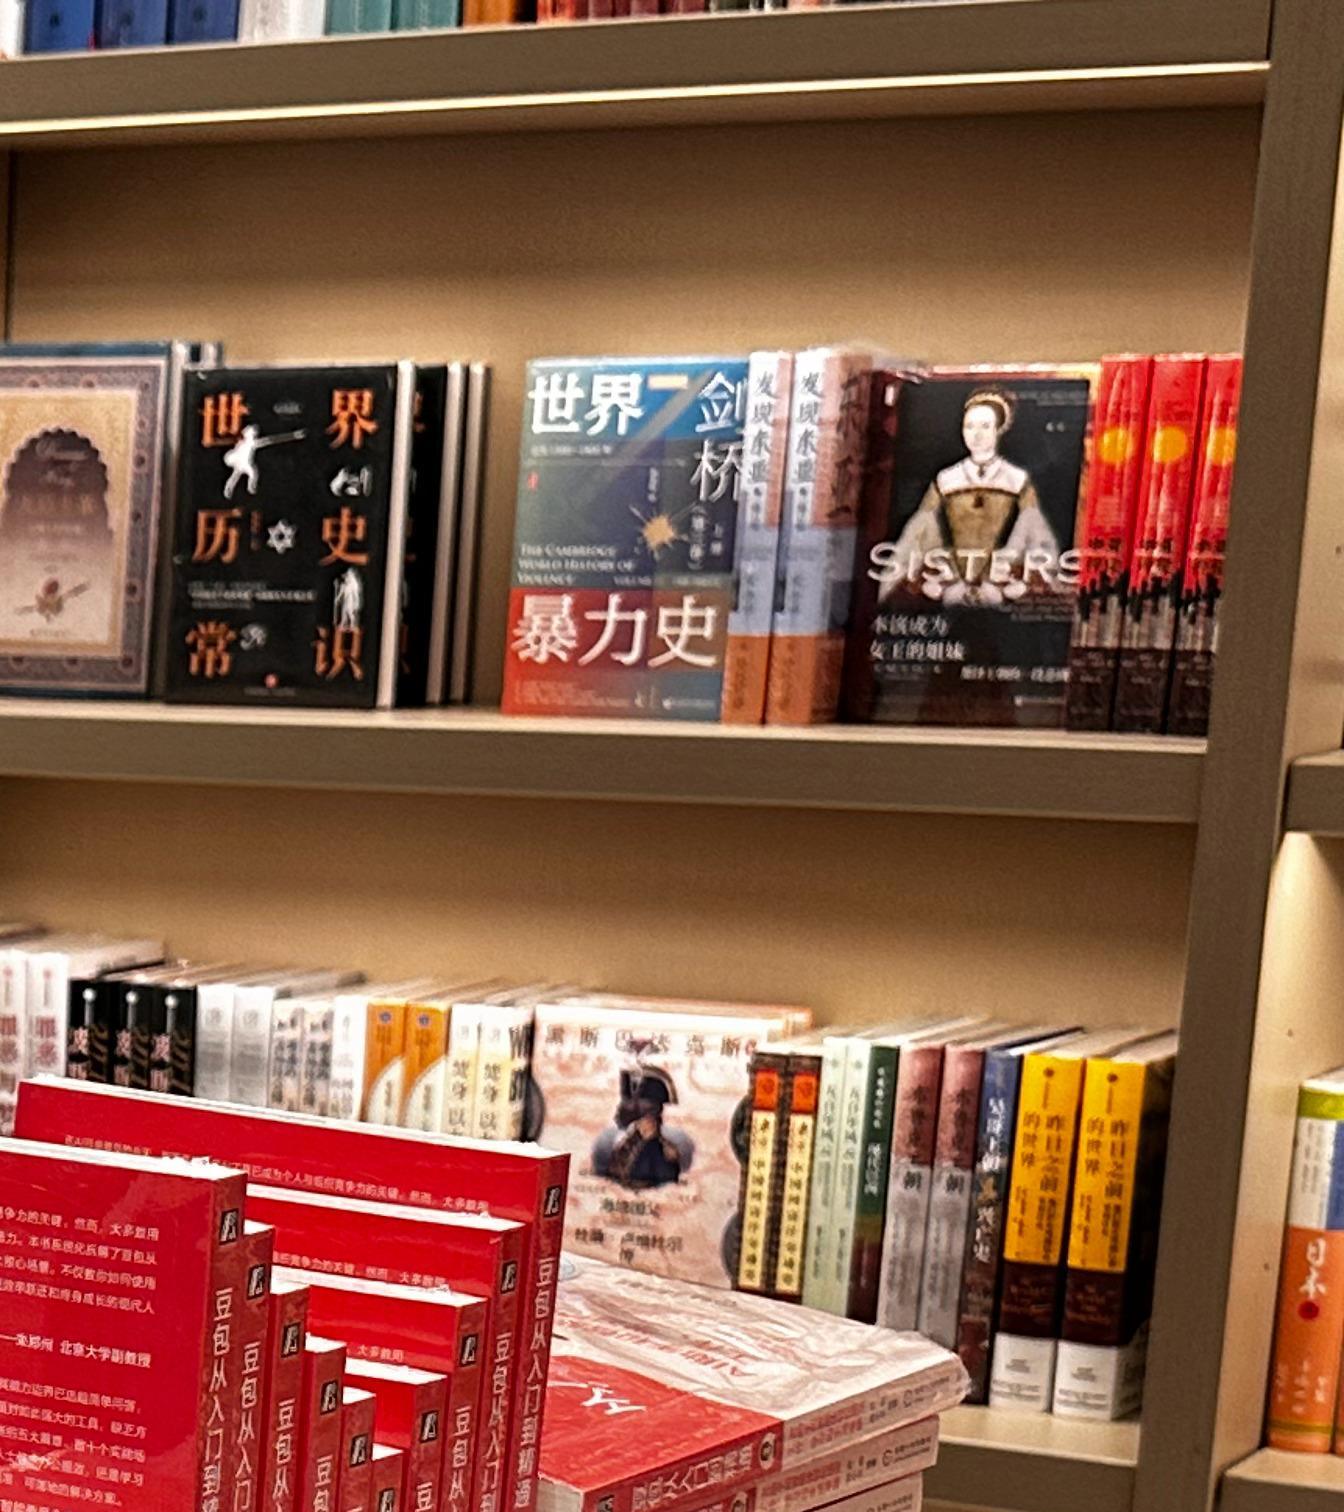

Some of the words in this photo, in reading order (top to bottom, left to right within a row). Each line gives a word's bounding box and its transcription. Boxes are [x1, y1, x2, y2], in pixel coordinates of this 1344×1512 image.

[527, 371, 646, 436] 世界
[868, 542, 1080, 585] SISTERS
[511, 593, 718, 668] 暴力史
[514, 1257, 554, 1510] 豆包从入门到精通
